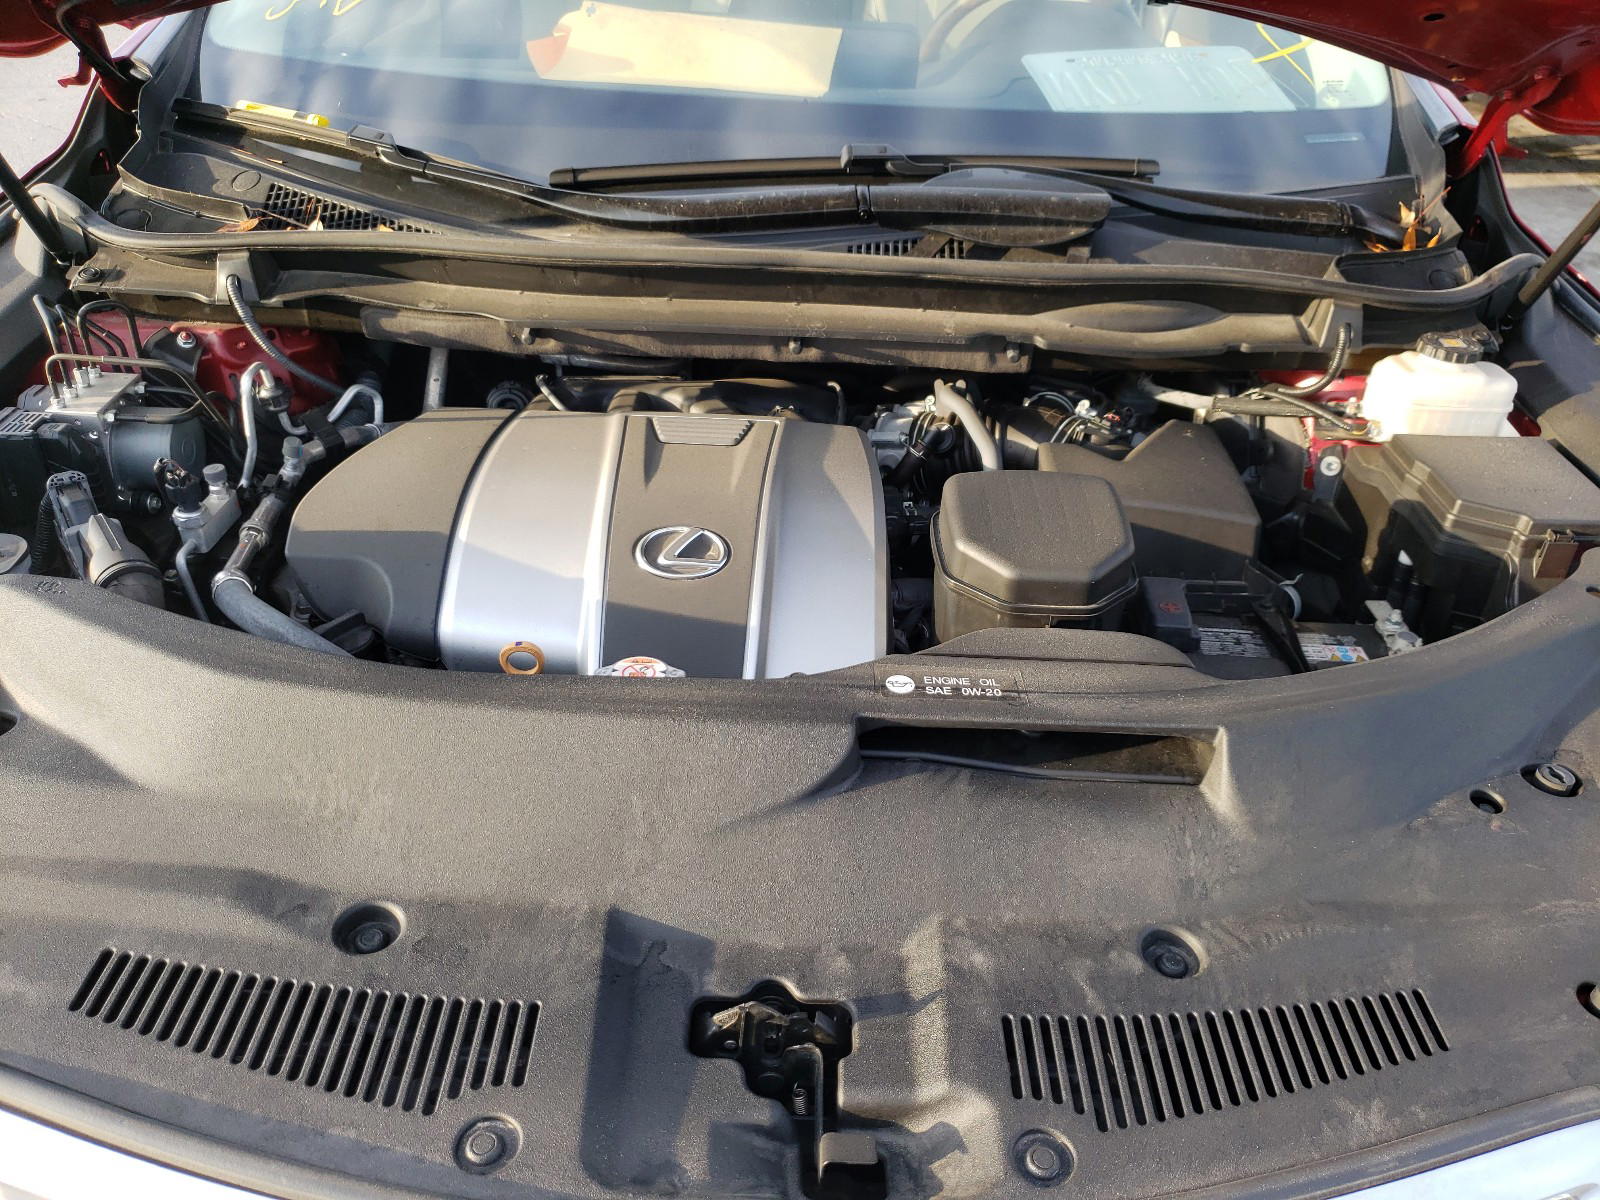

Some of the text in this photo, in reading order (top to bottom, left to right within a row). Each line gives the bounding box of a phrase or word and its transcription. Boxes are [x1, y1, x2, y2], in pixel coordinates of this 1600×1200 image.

[923, 676, 1000, 687] ENGINE OIL
[925, 686, 1002, 697] SAE 0W-20
